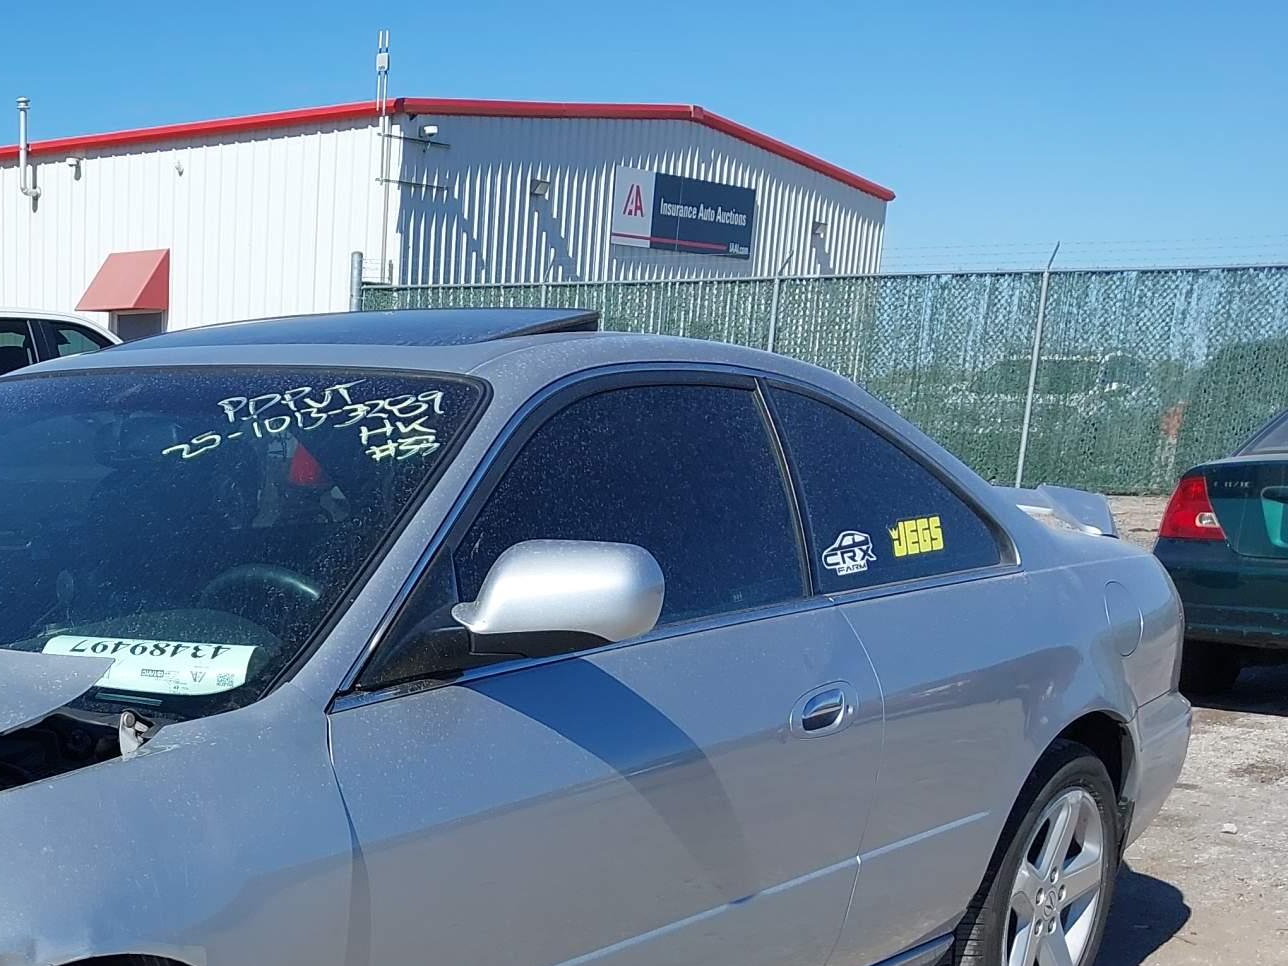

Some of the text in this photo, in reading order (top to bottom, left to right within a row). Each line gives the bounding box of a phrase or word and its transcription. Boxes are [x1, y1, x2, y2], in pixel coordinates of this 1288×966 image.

[660, 198, 747, 227] Insurance Auto Auctions
[889, 516, 944, 557] JEGS
[823, 545, 876, 567] CRX
[838, 563, 867, 574] FARM
[69, 639, 232, 660] 43489497
